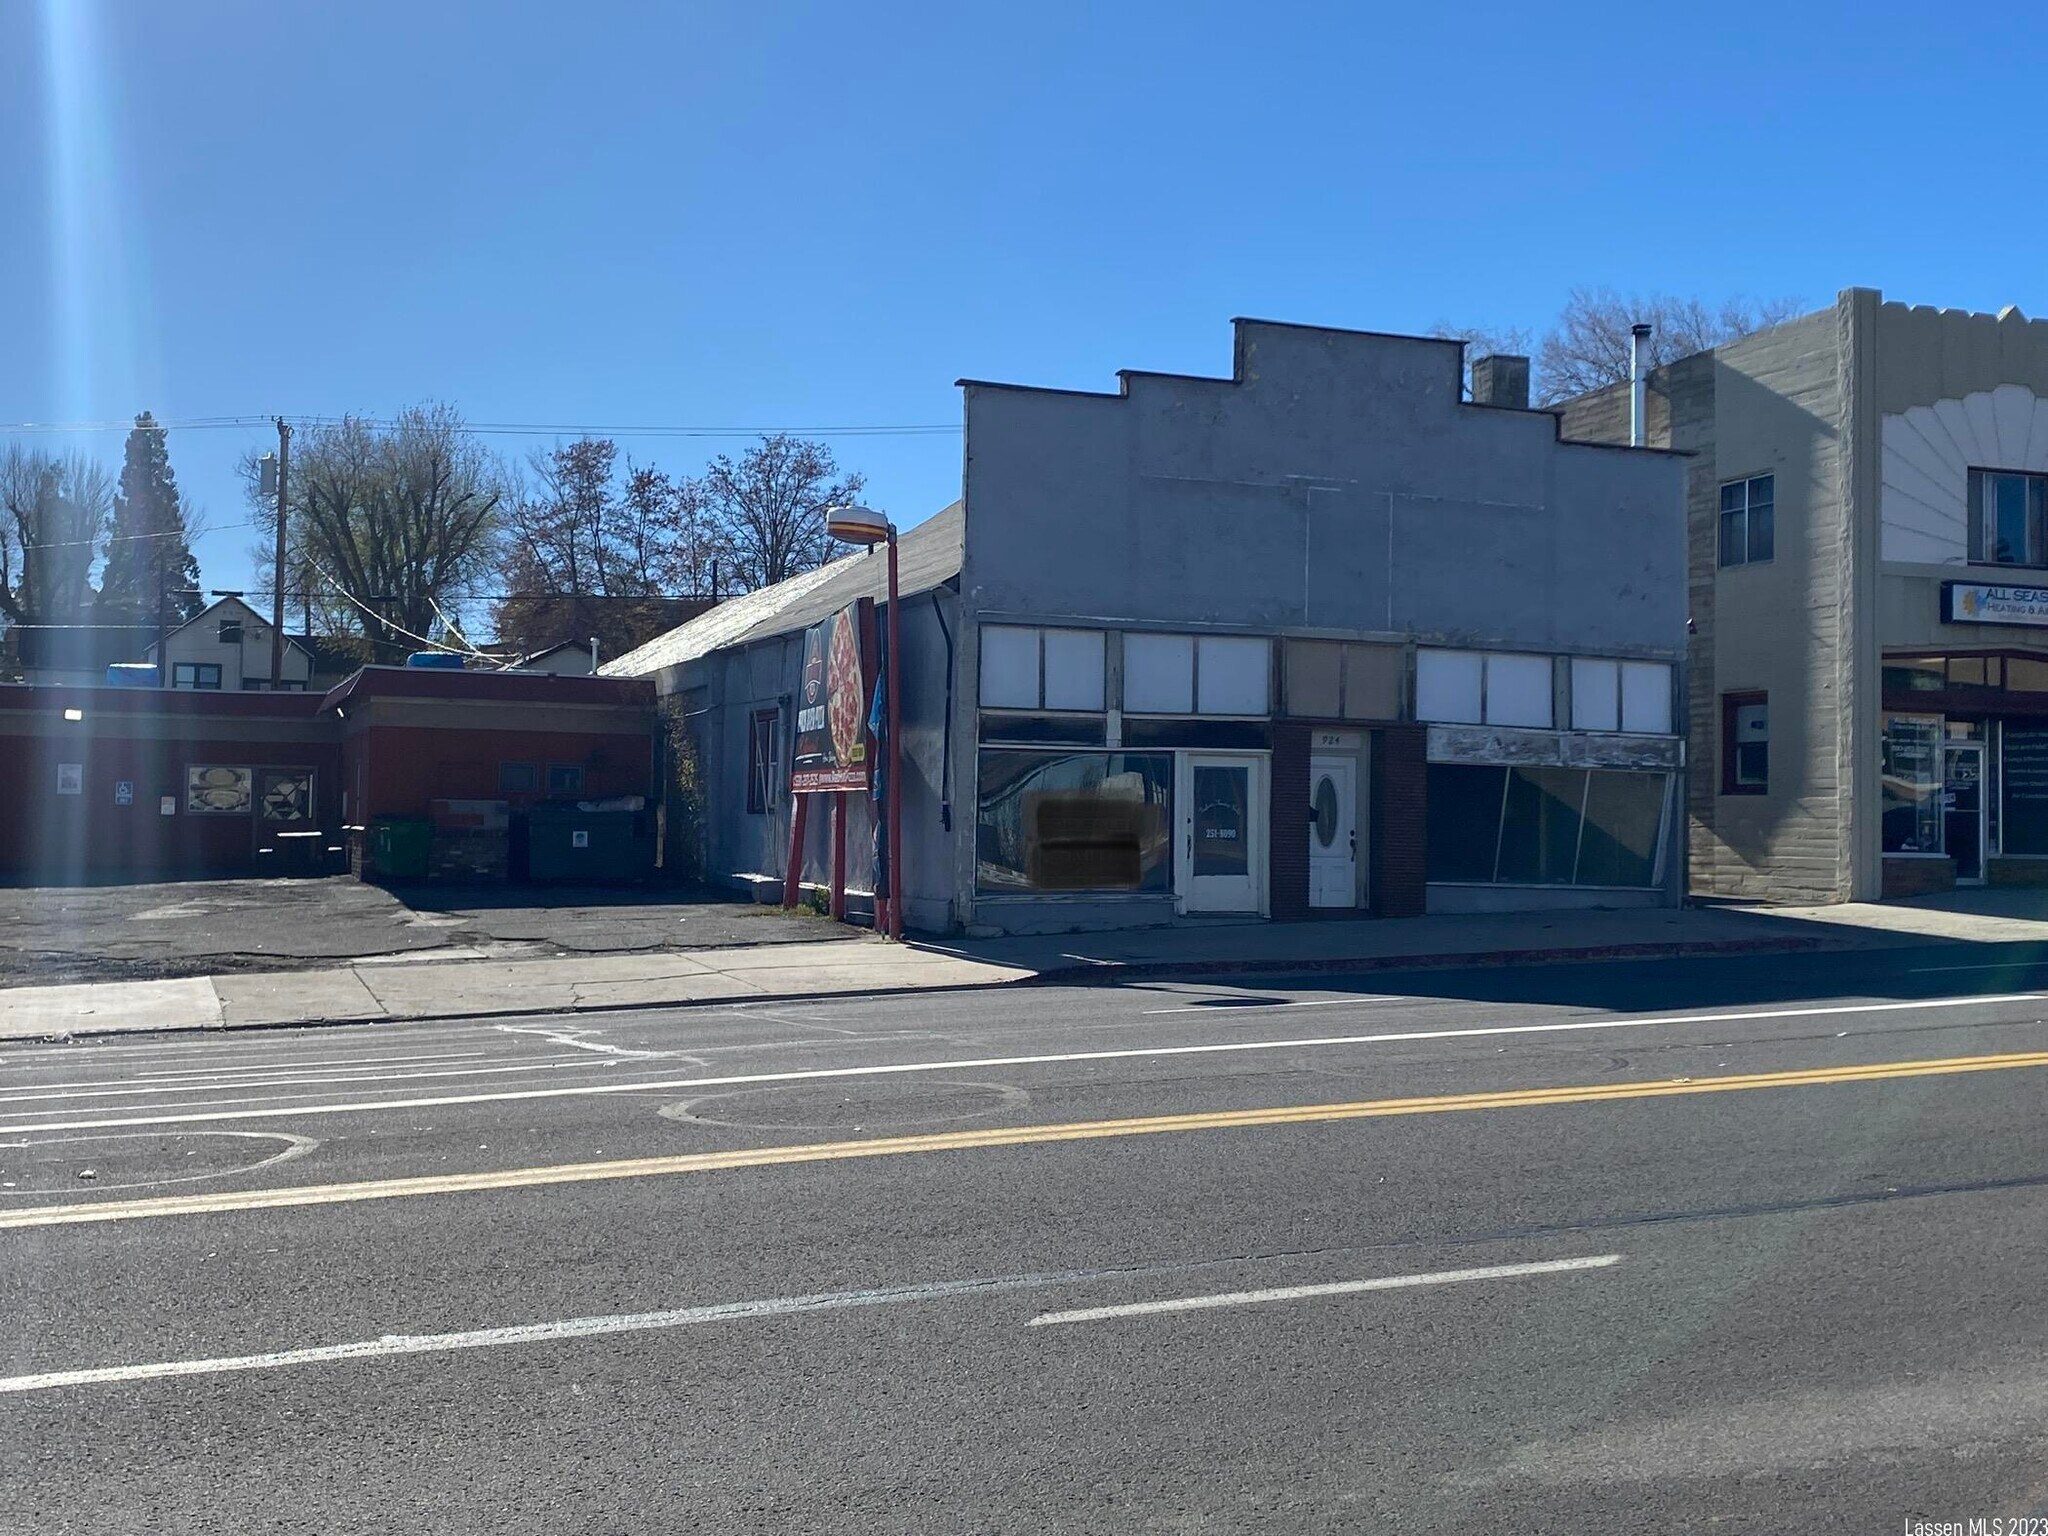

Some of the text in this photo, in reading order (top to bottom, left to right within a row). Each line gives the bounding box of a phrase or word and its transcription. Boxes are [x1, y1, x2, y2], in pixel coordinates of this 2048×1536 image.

[1986, 588, 2048, 603] ALL SEAS
[1987, 602, 2026, 614] HEATING
[2028, 605, 2035, 615] &
[1322, 735, 1340, 745] 924
